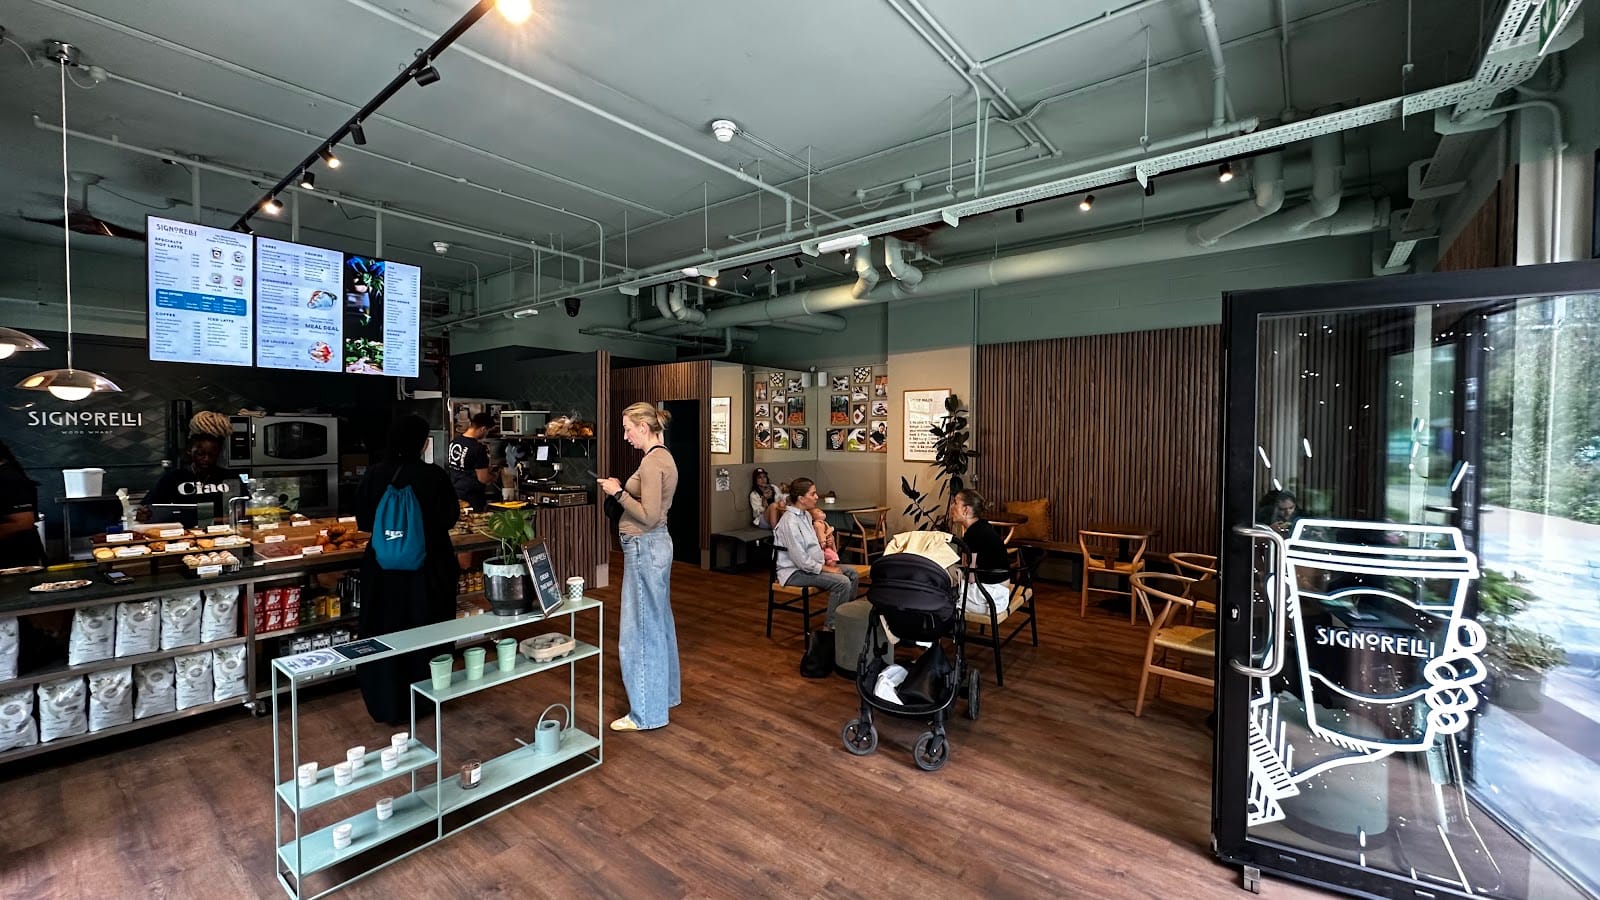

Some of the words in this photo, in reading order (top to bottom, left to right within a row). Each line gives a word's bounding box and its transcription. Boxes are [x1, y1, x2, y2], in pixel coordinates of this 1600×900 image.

[156, 223, 197, 237] SIGNORELLI
[305, 323, 322, 331] MEAL
[28, 411, 142, 426] SIGNORELLI
[177, 481, 230, 495] Ciao
[1316, 627, 1435, 659] SIGNORELLI
